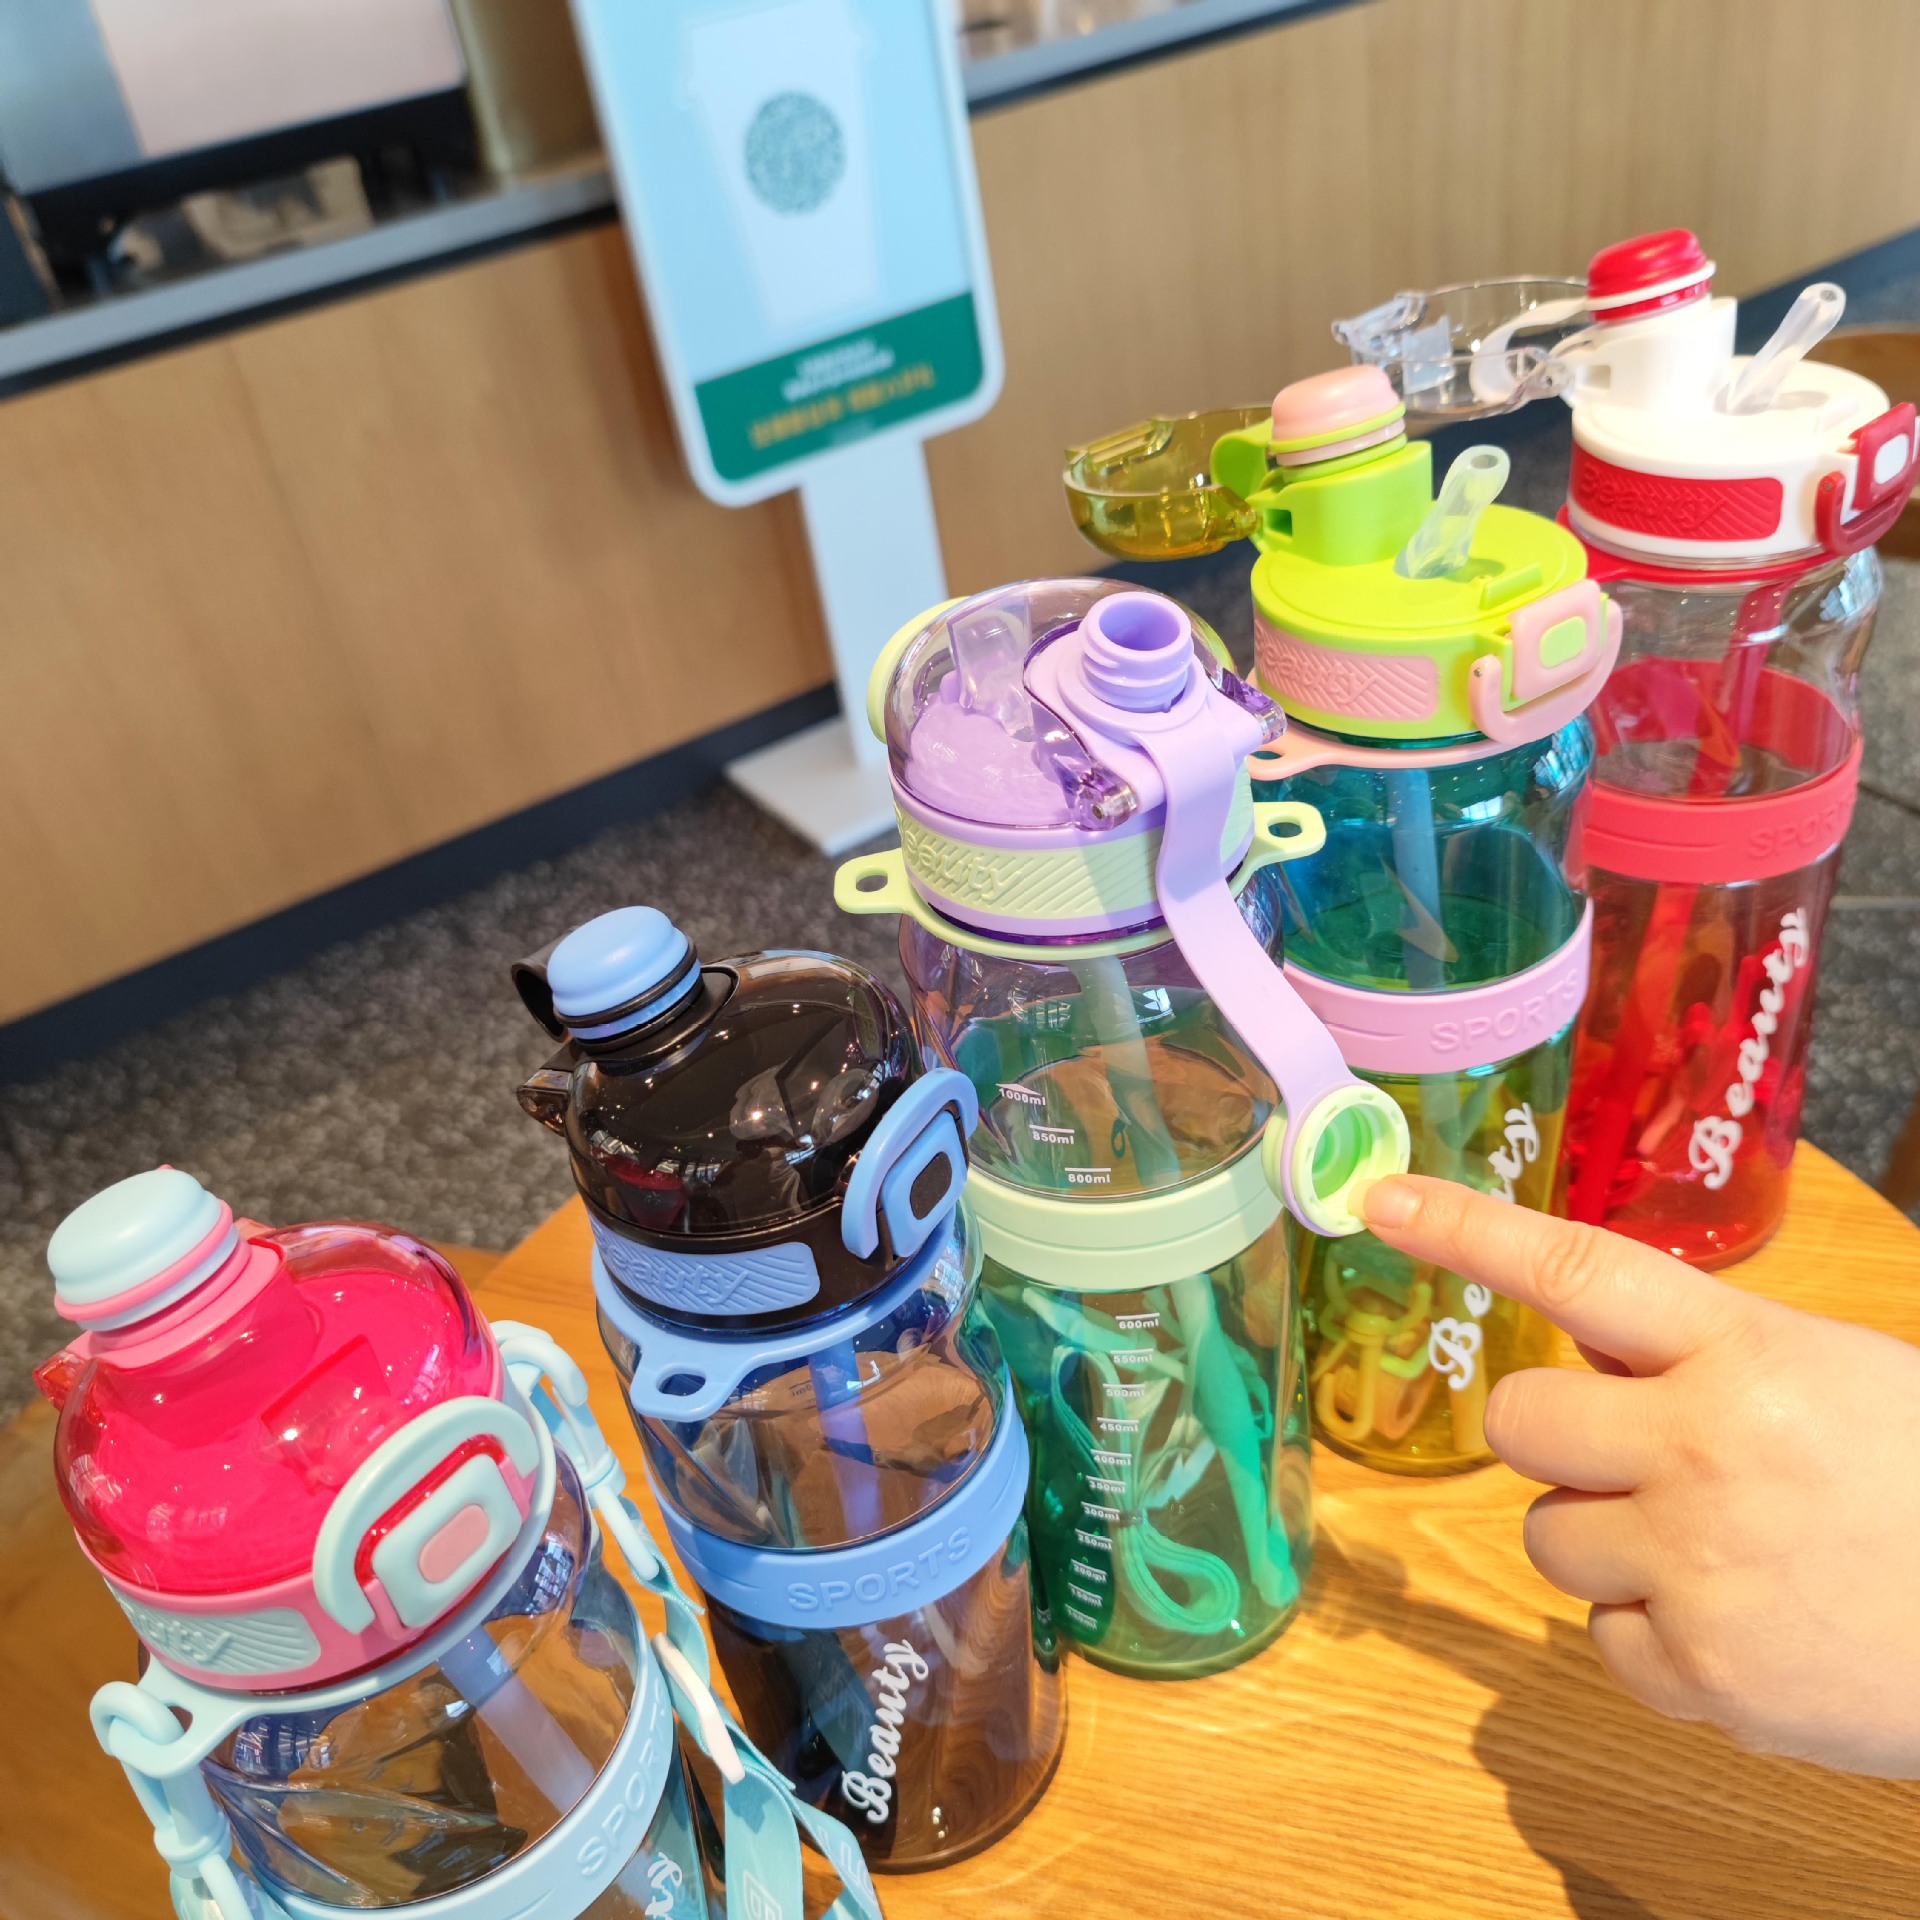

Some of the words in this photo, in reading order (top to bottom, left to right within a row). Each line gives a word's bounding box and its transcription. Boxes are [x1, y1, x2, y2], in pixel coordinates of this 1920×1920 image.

[1429, 967, 1578, 1053] SPORTS
[1688, 907, 1810, 1190] Beauty
[999, 1088, 1046, 1106] 1000ml
[1032, 1130, 1075, 1145] 850ml
[1067, 1173, 1111, 1184] 800ml
[1428, 1102, 1540, 1391] Bety
[1118, 1317, 1160, 1330] 600ml
[1112, 1353, 1154, 1364] 550ml
[1105, 1387, 1146, 1398] 500ml
[1099, 1421, 1139, 1433] 450ml
[1093, 1454, 1132, 1467] 400ml
[1088, 1479, 1126, 1494] 350ml
[1083, 1506, 1120, 1521] 300ml
[1077, 1533, 1113, 1551] 250ml
[787, 1526, 972, 1611] SPORTS
[841, 1639, 929, 1824] Beauty
